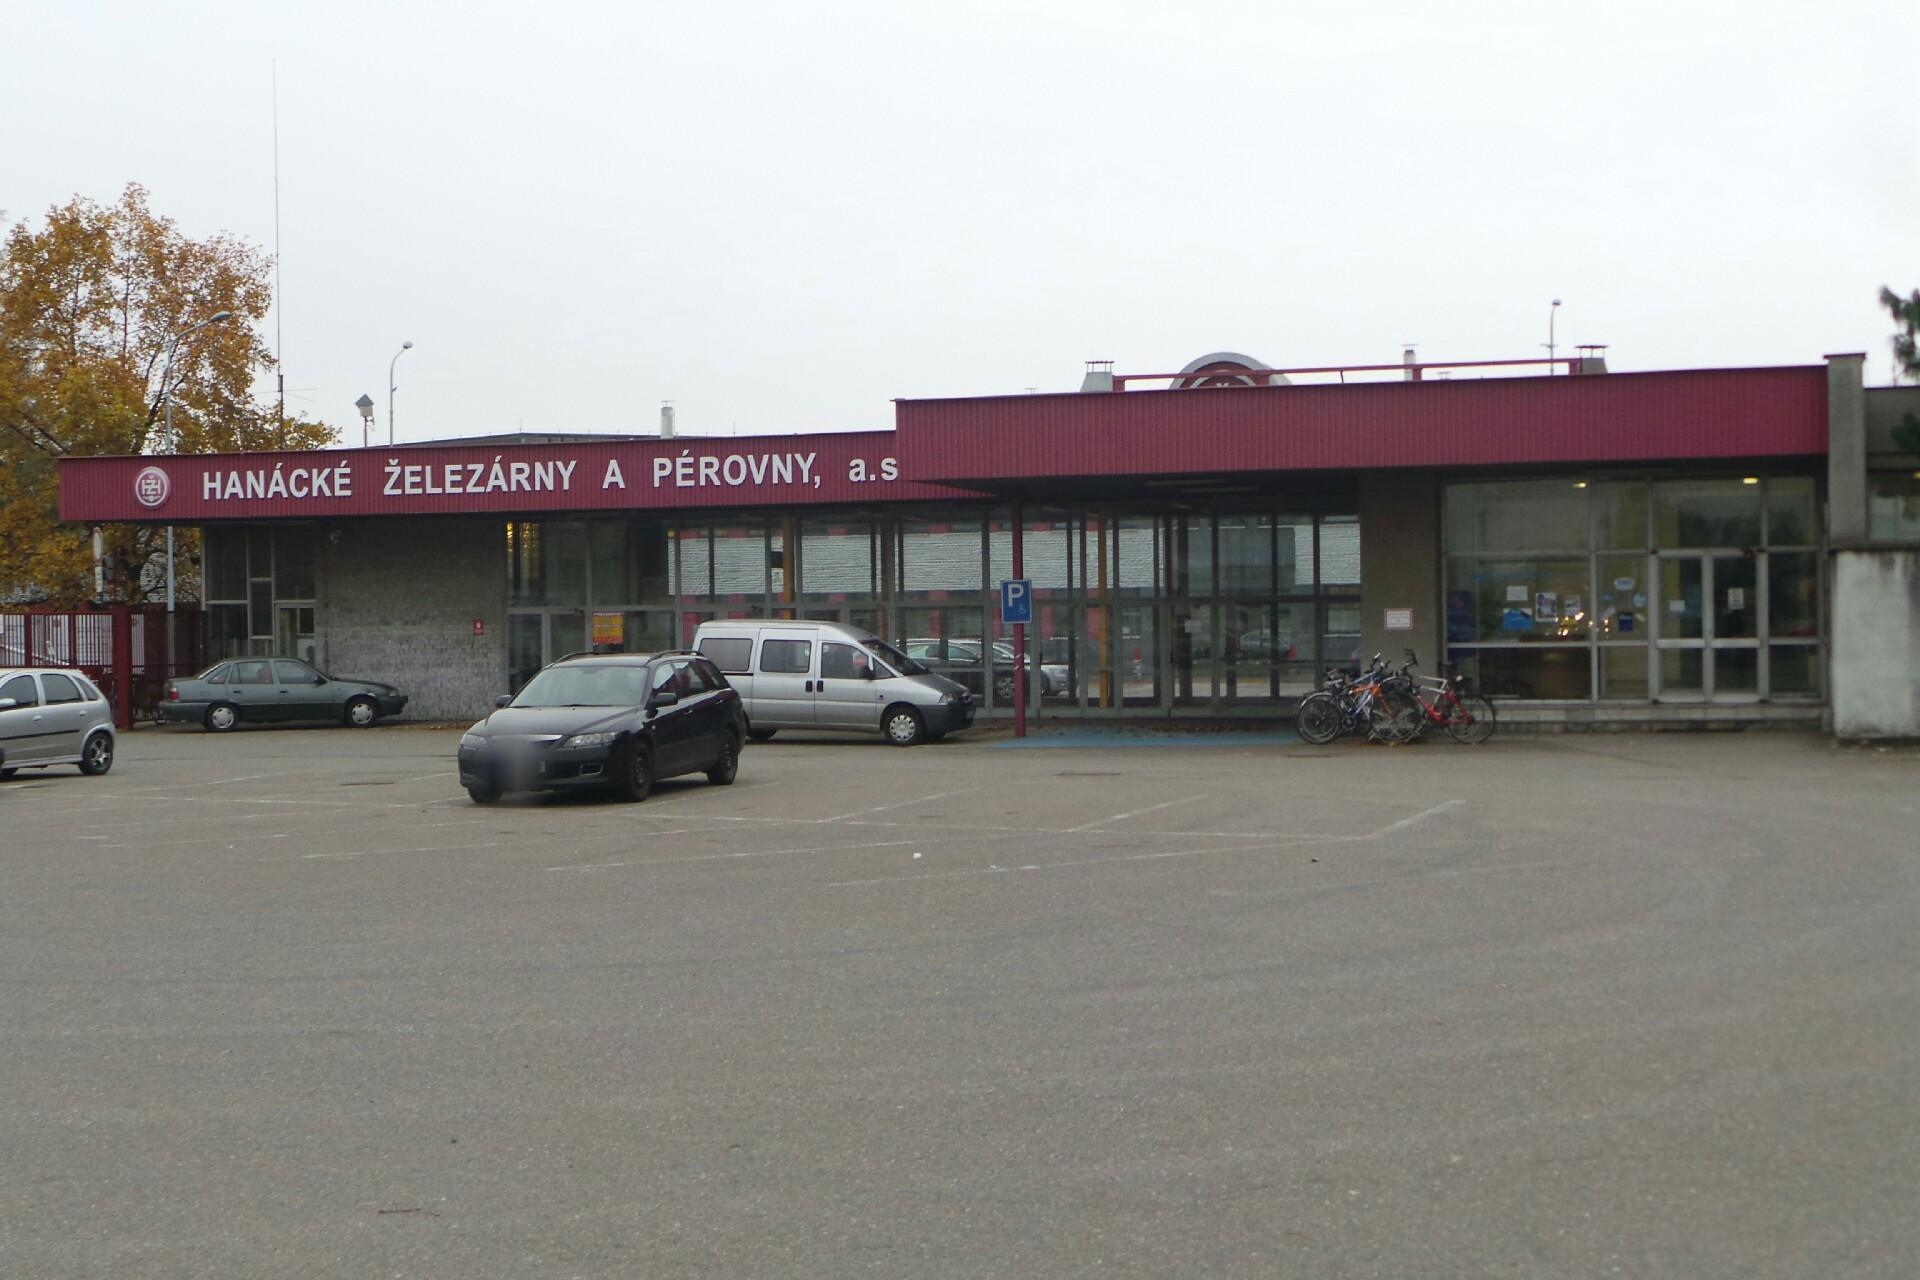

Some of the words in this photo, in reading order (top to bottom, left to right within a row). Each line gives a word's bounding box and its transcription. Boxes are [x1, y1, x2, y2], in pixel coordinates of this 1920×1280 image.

[203, 460, 352, 500] HANÁCKÉ
[383, 456, 577, 496] ŽELEZÁRNY
[602, 459, 626, 489] A
[652, 449, 821, 489] PÉROVNY,
[848, 457, 898, 481] a.s
[1007, 583, 1024, 607] P
